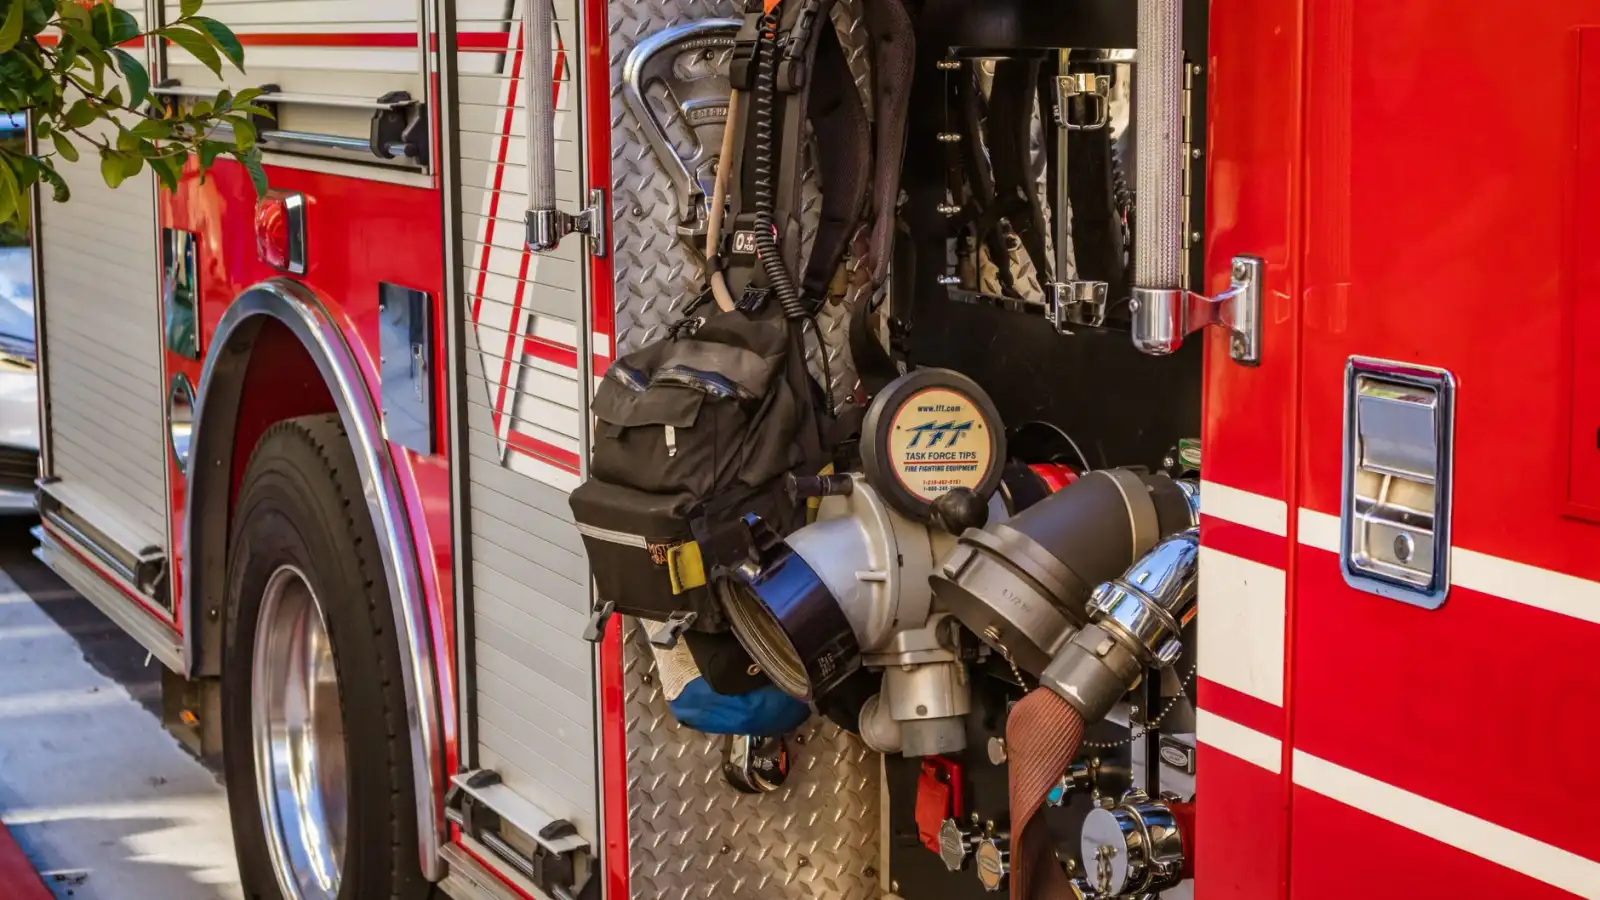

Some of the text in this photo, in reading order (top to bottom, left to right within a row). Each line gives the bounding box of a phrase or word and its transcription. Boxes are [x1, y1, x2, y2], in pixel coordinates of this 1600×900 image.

[905, 451, 977, 460] TASK FORCE TIPS
[946, 464, 978, 472] EQUIPMENT
